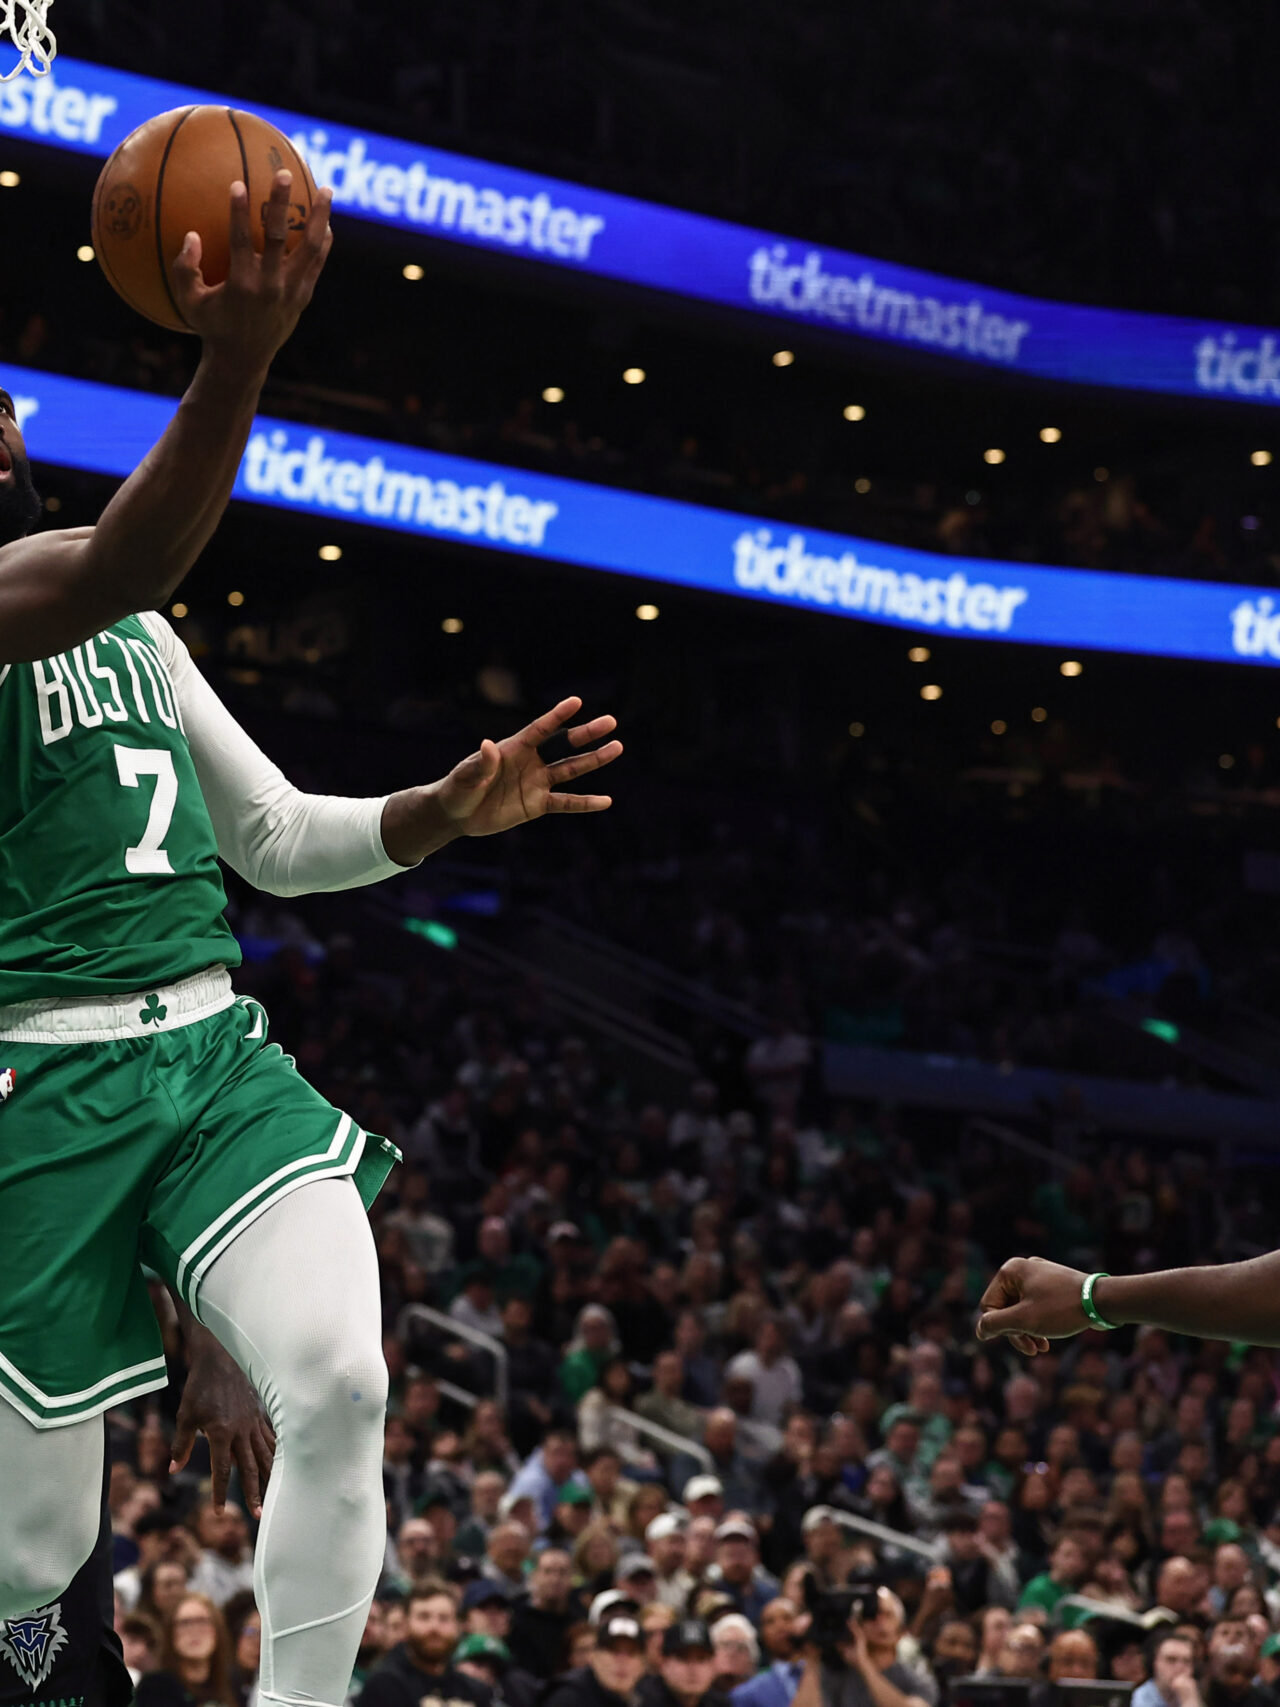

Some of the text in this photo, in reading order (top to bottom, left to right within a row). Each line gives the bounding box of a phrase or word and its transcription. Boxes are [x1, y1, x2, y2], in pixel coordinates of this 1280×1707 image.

[748, 244, 1029, 361] ticketmaster
[243, 430, 557, 546] ticketmaster
[732, 528, 1026, 632] ticketmaster
[32, 630, 186, 746] BOSTO
[114, 743, 179, 874] 7
